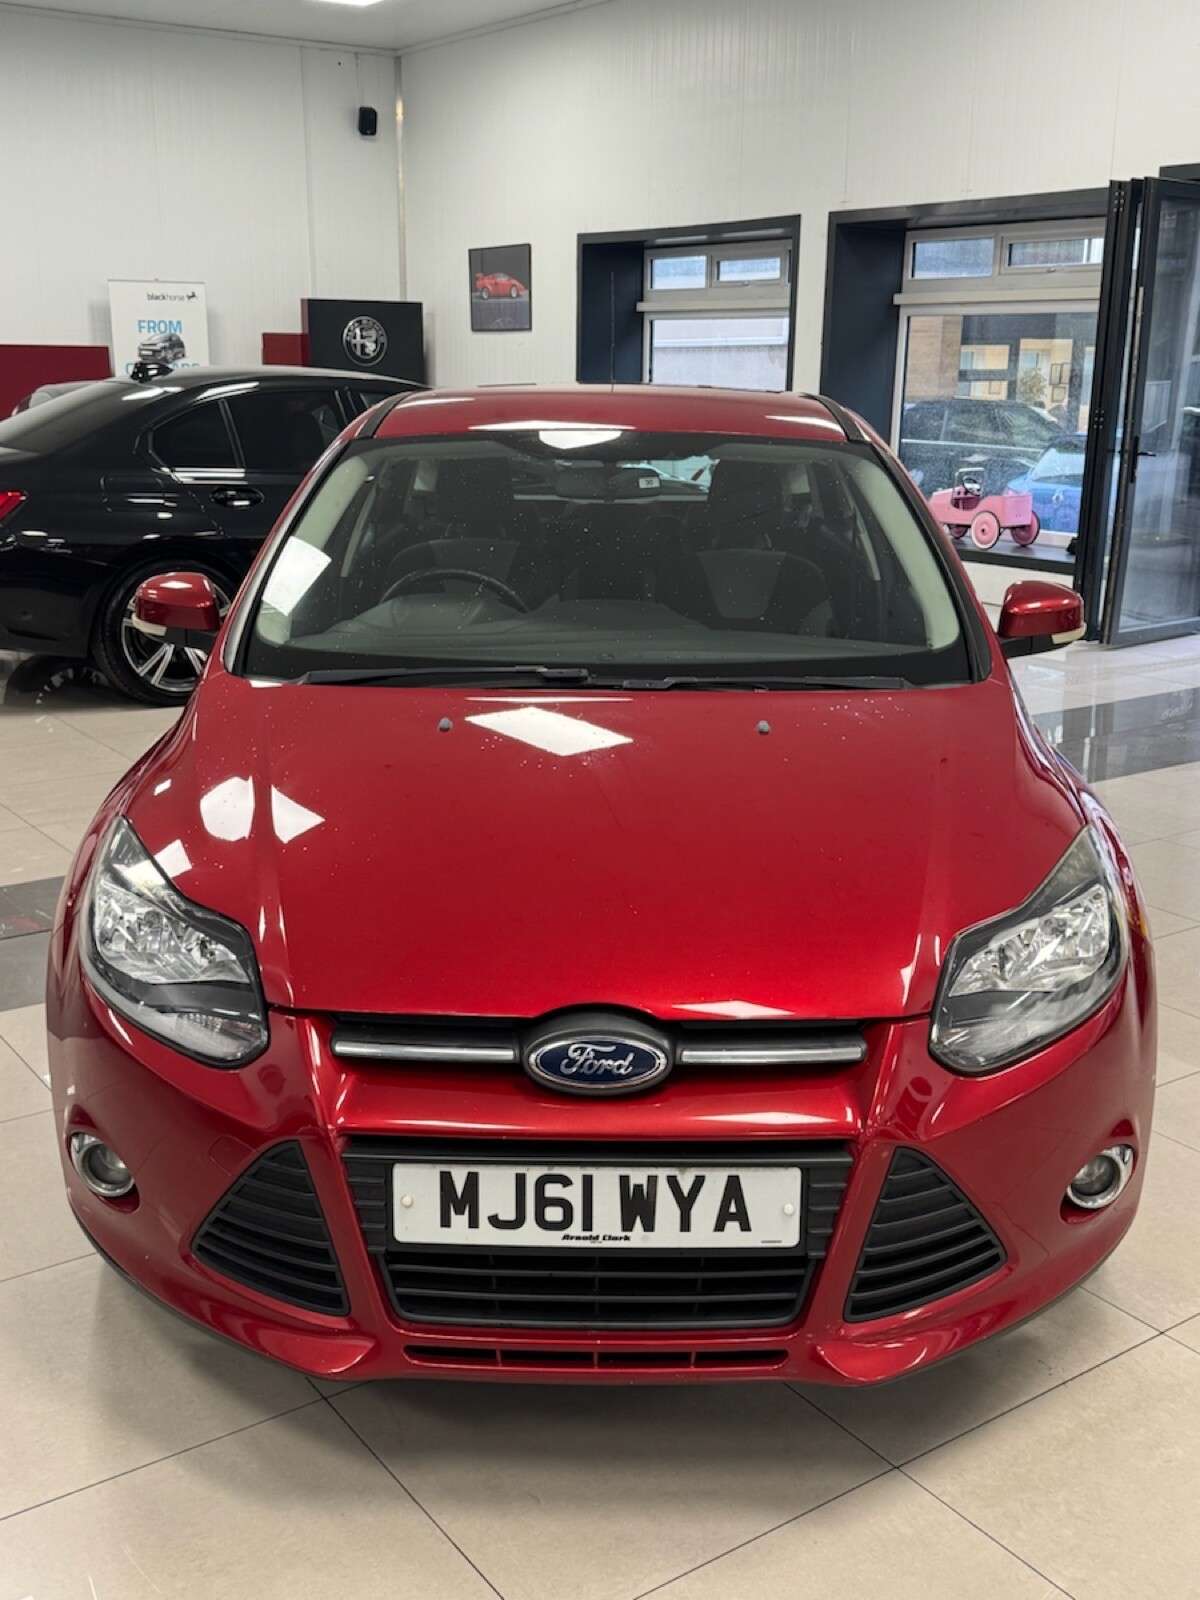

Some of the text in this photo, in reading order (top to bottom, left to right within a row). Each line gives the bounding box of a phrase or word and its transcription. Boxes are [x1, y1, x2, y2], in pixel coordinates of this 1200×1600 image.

[137, 319, 183, 334] FROM
[560, 1043, 635, 1075] Ford
[439, 1171, 752, 1233] MJ61 WYA
